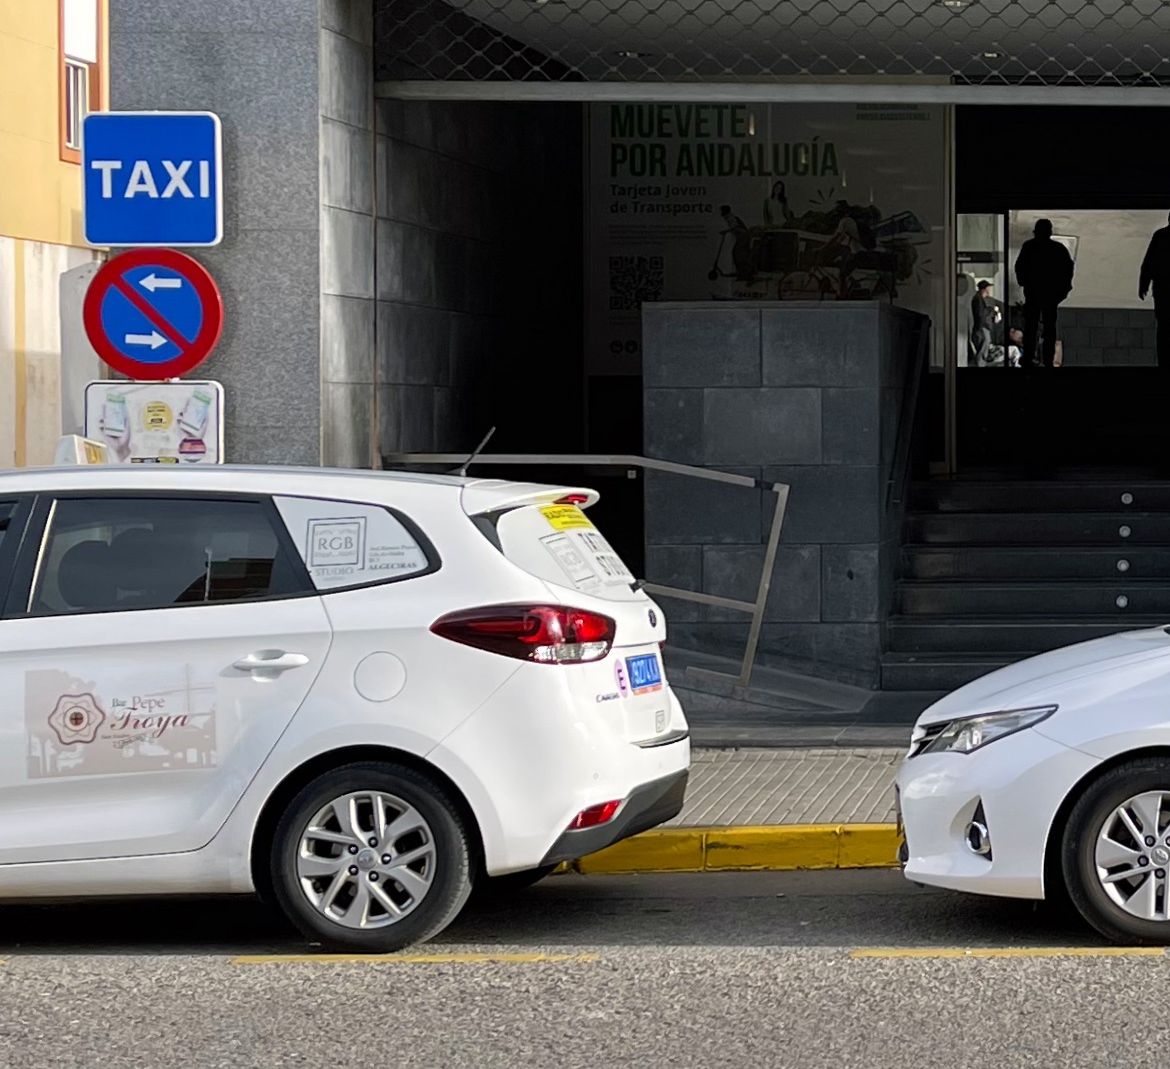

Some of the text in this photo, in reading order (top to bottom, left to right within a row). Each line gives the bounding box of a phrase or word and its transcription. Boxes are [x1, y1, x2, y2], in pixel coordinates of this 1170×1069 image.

[610, 136, 839, 178] POR ANDALUCÍA
[91, 160, 210, 199] TAXI
[609, 184, 707, 199] Tarjeta Joven
[609, 201, 713, 217] de Transporte
[318, 536, 354, 551] RGB
[315, 566, 354, 577] STUDIO
[368, 562, 418, 571] ALGECIRAS
[617, 669, 627, 690] E
[132, 695, 166, 713] Pepe
[110, 707, 188, 739] Troya
